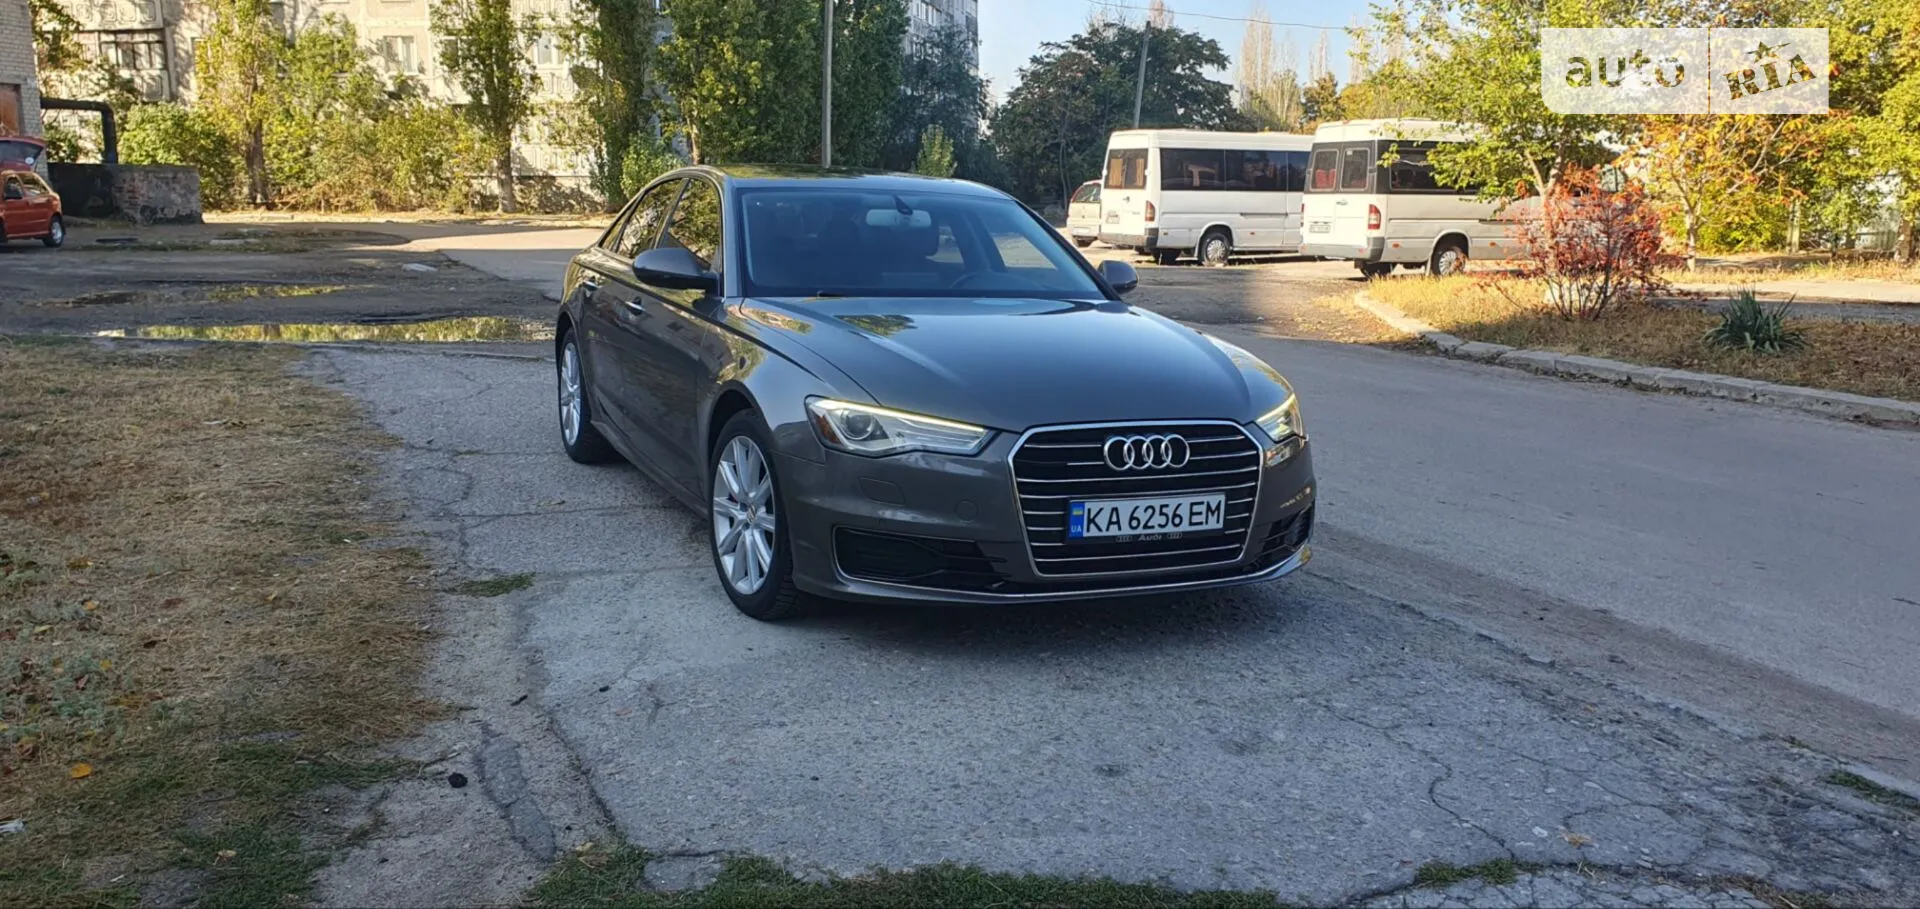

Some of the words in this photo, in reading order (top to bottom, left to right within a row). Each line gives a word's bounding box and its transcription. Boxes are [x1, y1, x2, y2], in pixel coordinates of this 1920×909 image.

[1086, 506, 1122, 533] KA
[1128, 503, 1183, 530] 6256
[1189, 500, 1222, 526] EM
[1071, 525, 1082, 533] UA
